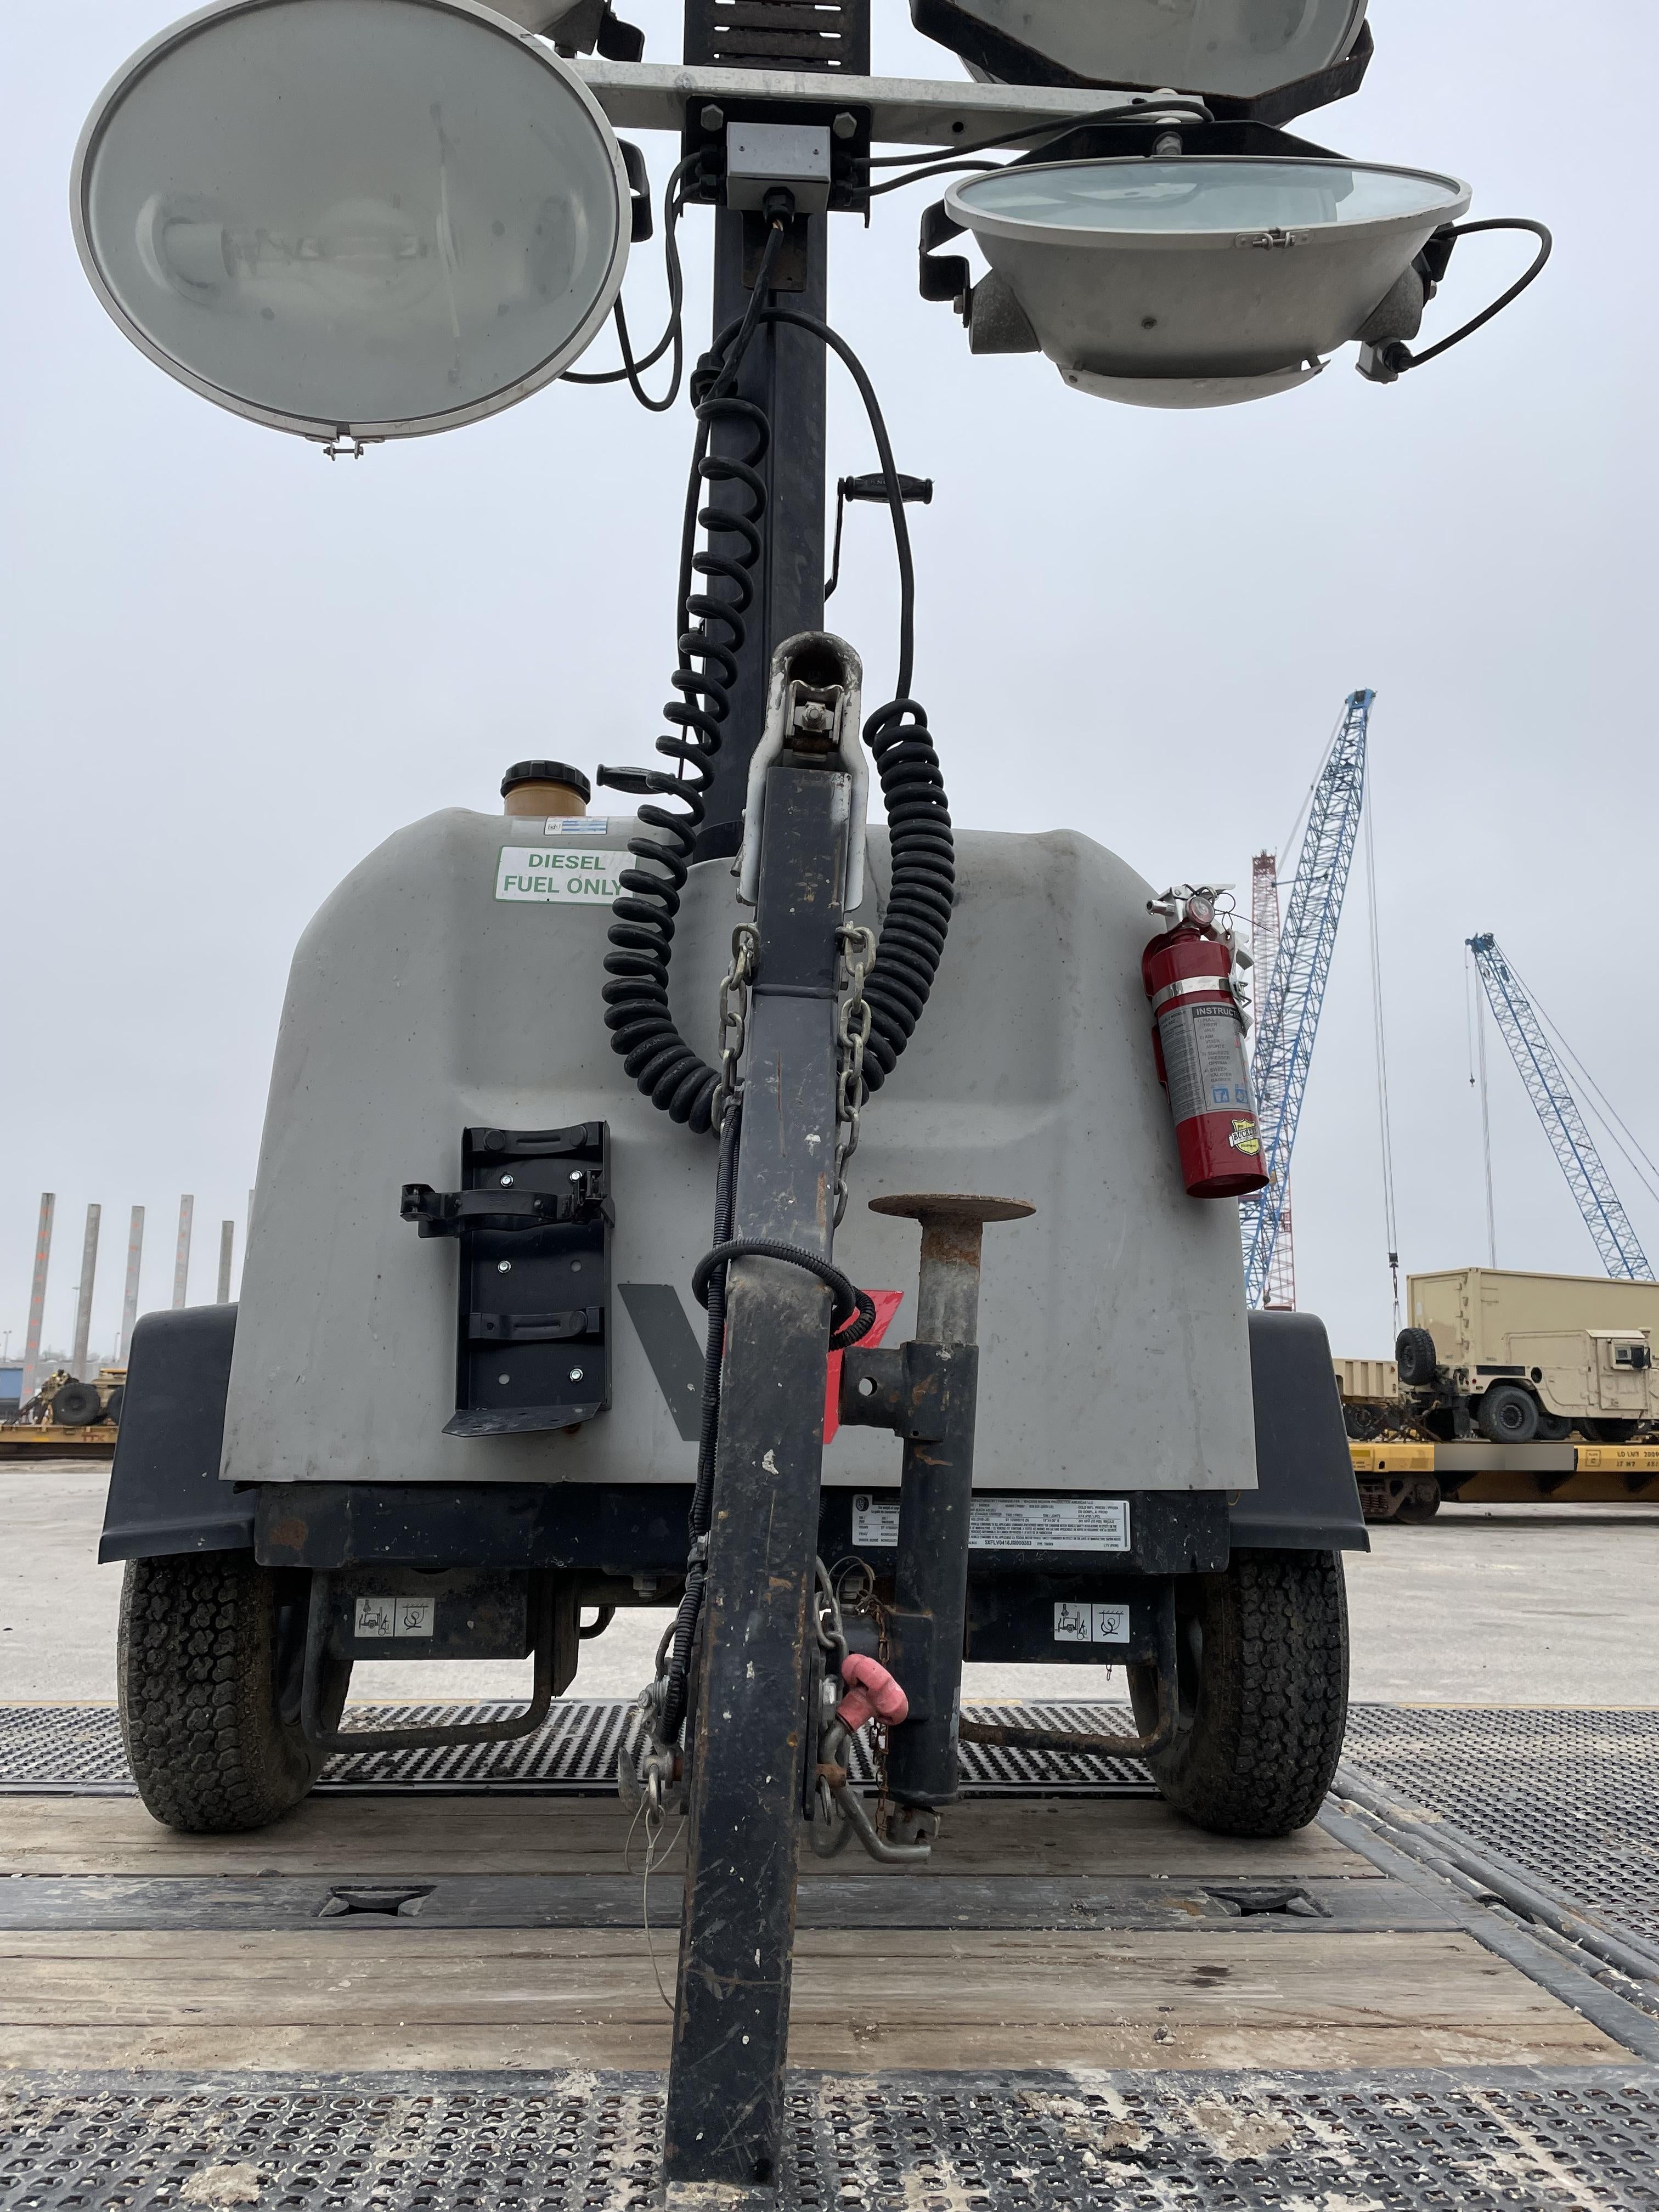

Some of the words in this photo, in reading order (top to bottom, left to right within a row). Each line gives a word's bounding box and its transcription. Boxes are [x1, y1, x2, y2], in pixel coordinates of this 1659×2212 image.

[529, 854, 606, 871] DIESEL
[504, 876, 560, 894] FUEL
[567, 877, 623, 896] ONLY
